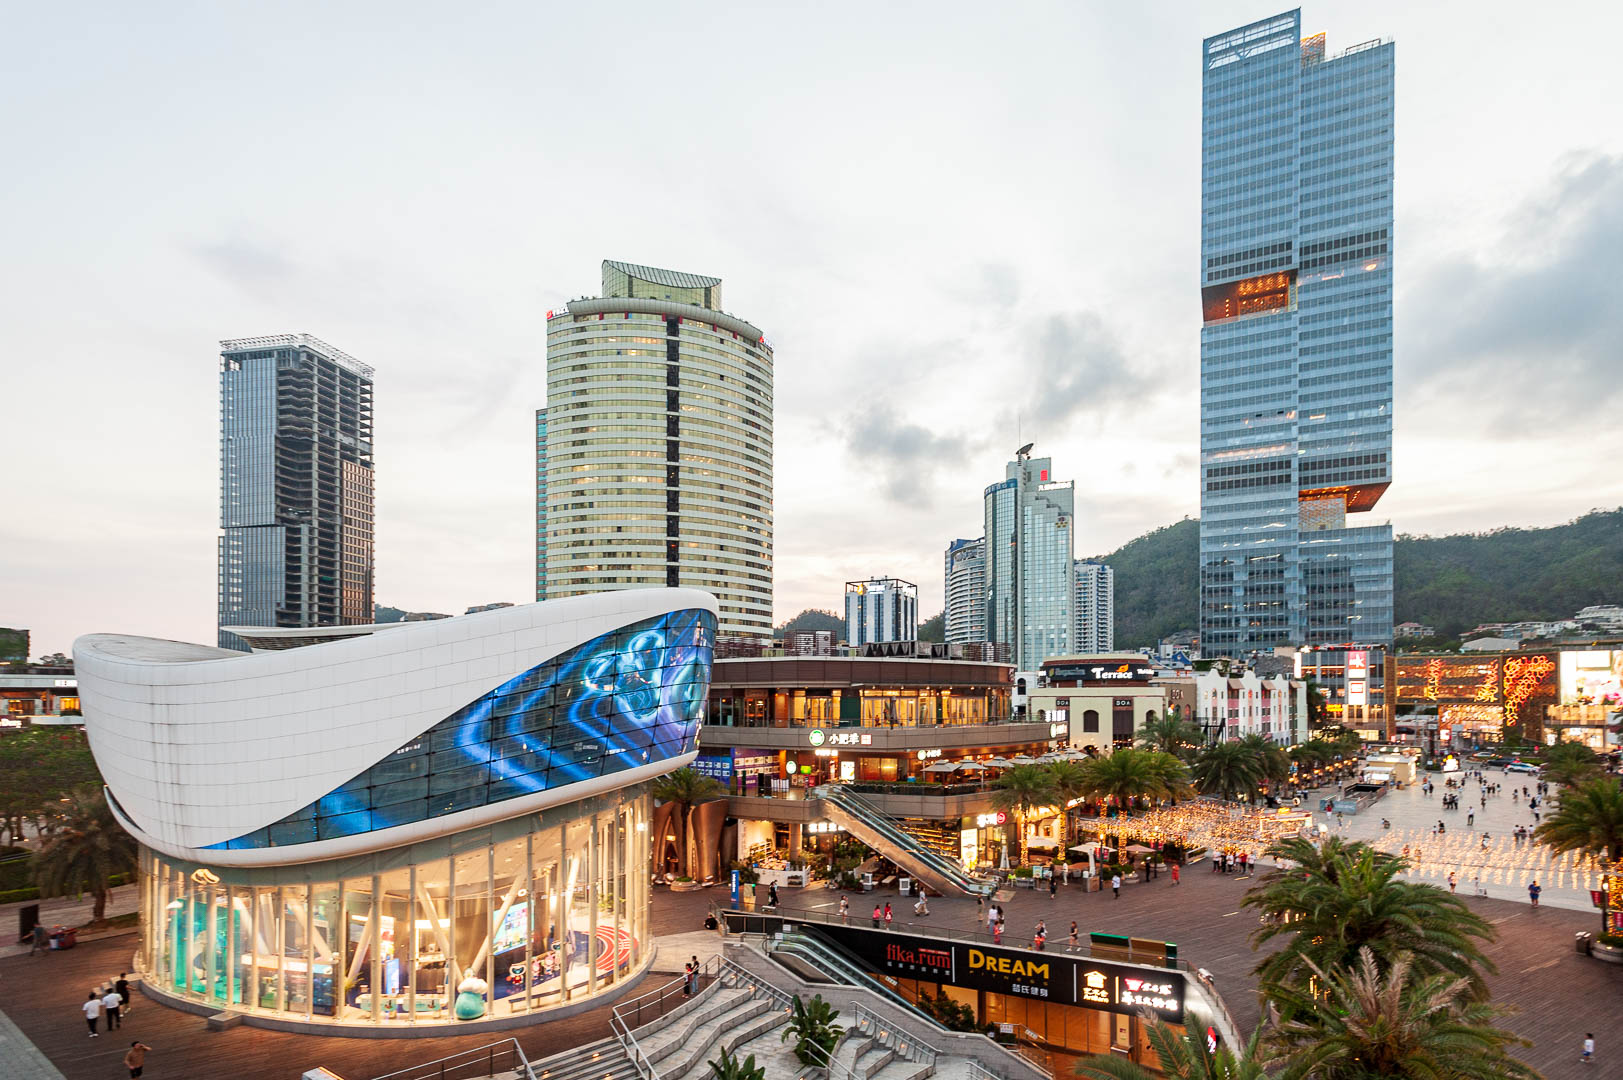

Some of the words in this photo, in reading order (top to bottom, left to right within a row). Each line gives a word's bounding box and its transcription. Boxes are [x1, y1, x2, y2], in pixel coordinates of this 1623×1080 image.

[1091, 667, 1133, 679] Terrace
[829, 733, 860, 745] 小肥羊
[886, 944, 950, 968] fika.rum
[968, 949, 1049, 979] DREAM
